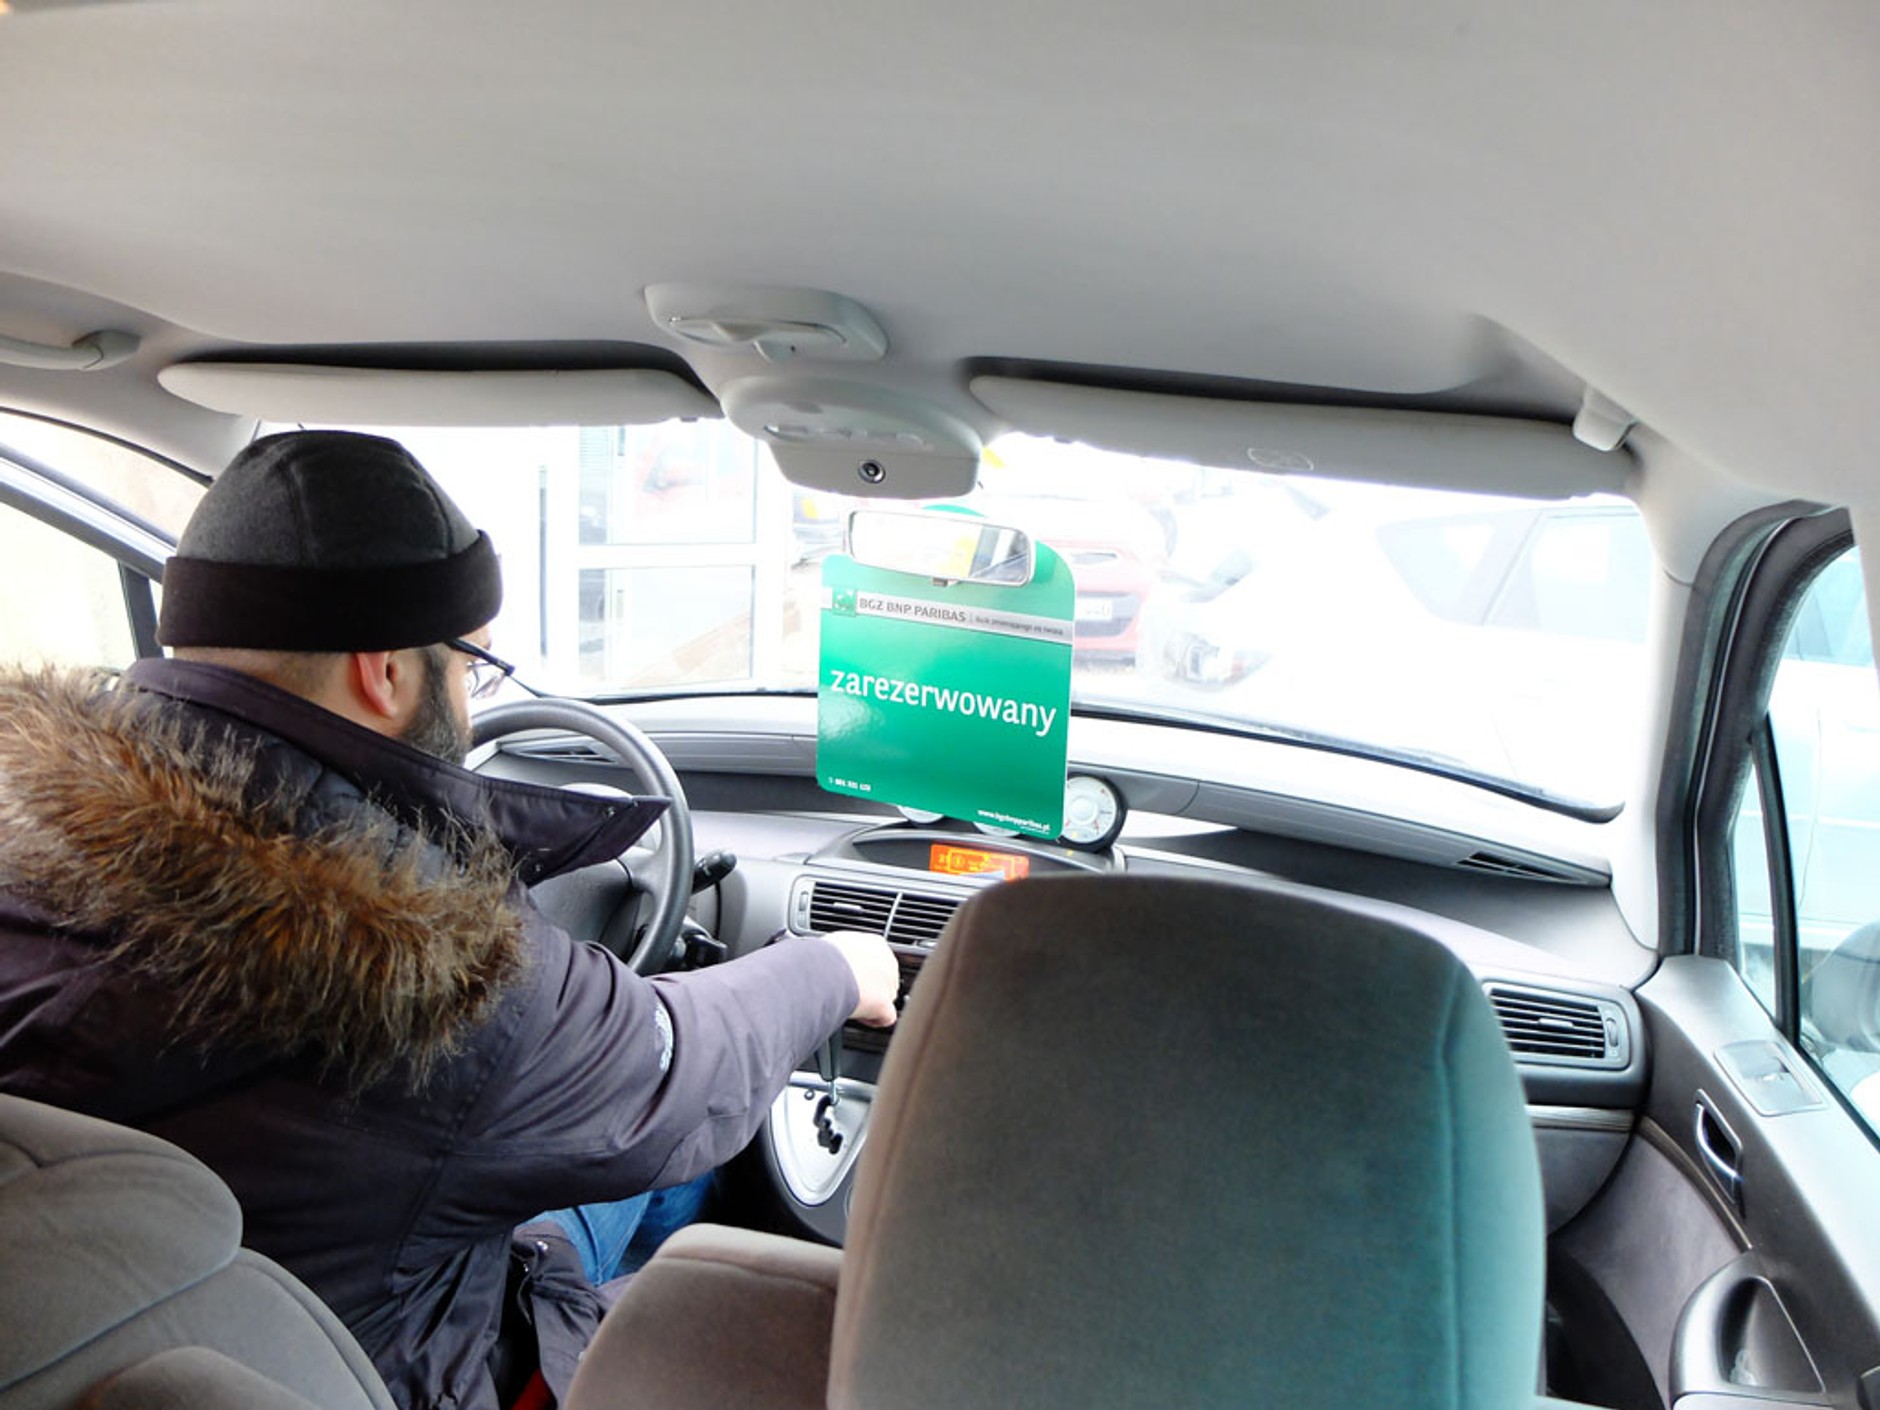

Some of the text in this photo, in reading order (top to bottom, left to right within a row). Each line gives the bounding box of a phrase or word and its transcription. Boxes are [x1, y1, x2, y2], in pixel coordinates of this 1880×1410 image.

[886, 602, 912, 615] BNP
[913, 606, 966, 622] PARIBAS
[830, 669, 1057, 737] zarezerwowany
